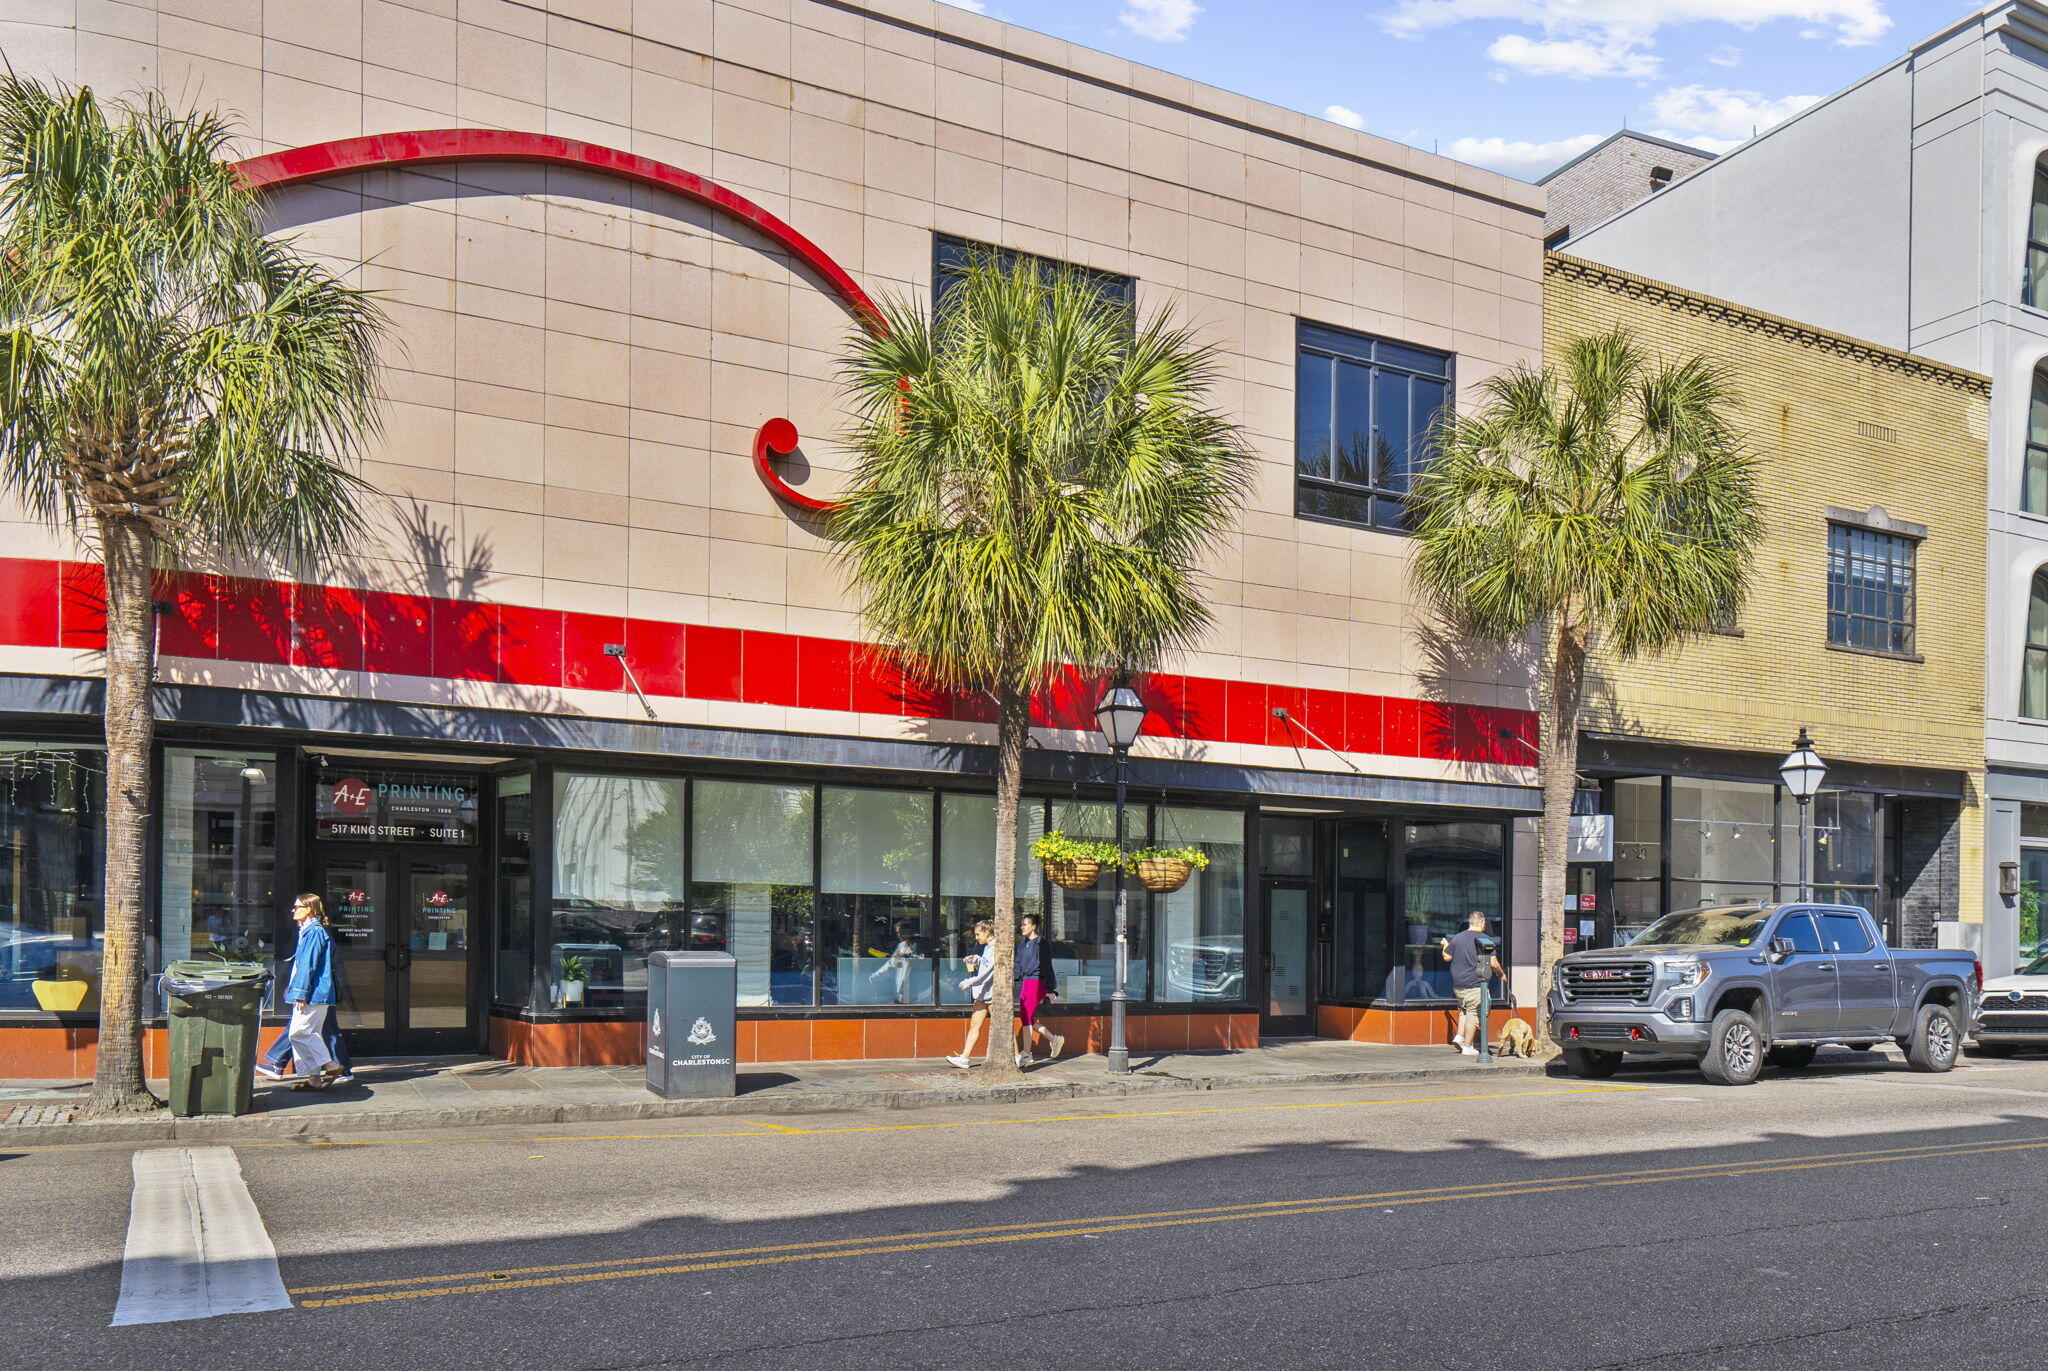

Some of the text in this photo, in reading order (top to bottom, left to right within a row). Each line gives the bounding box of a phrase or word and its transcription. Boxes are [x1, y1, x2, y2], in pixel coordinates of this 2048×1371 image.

[378, 783, 465, 801] PRINTING
[391, 805, 430, 813] CHARLESTON
[331, 824, 465, 838] 517 KING STREET SUITE 1
[338, 905, 375, 913] PRINTING
[1583, 970, 1621, 980] GMC
[672, 1058, 731, 1067] CHARLESTONSC
